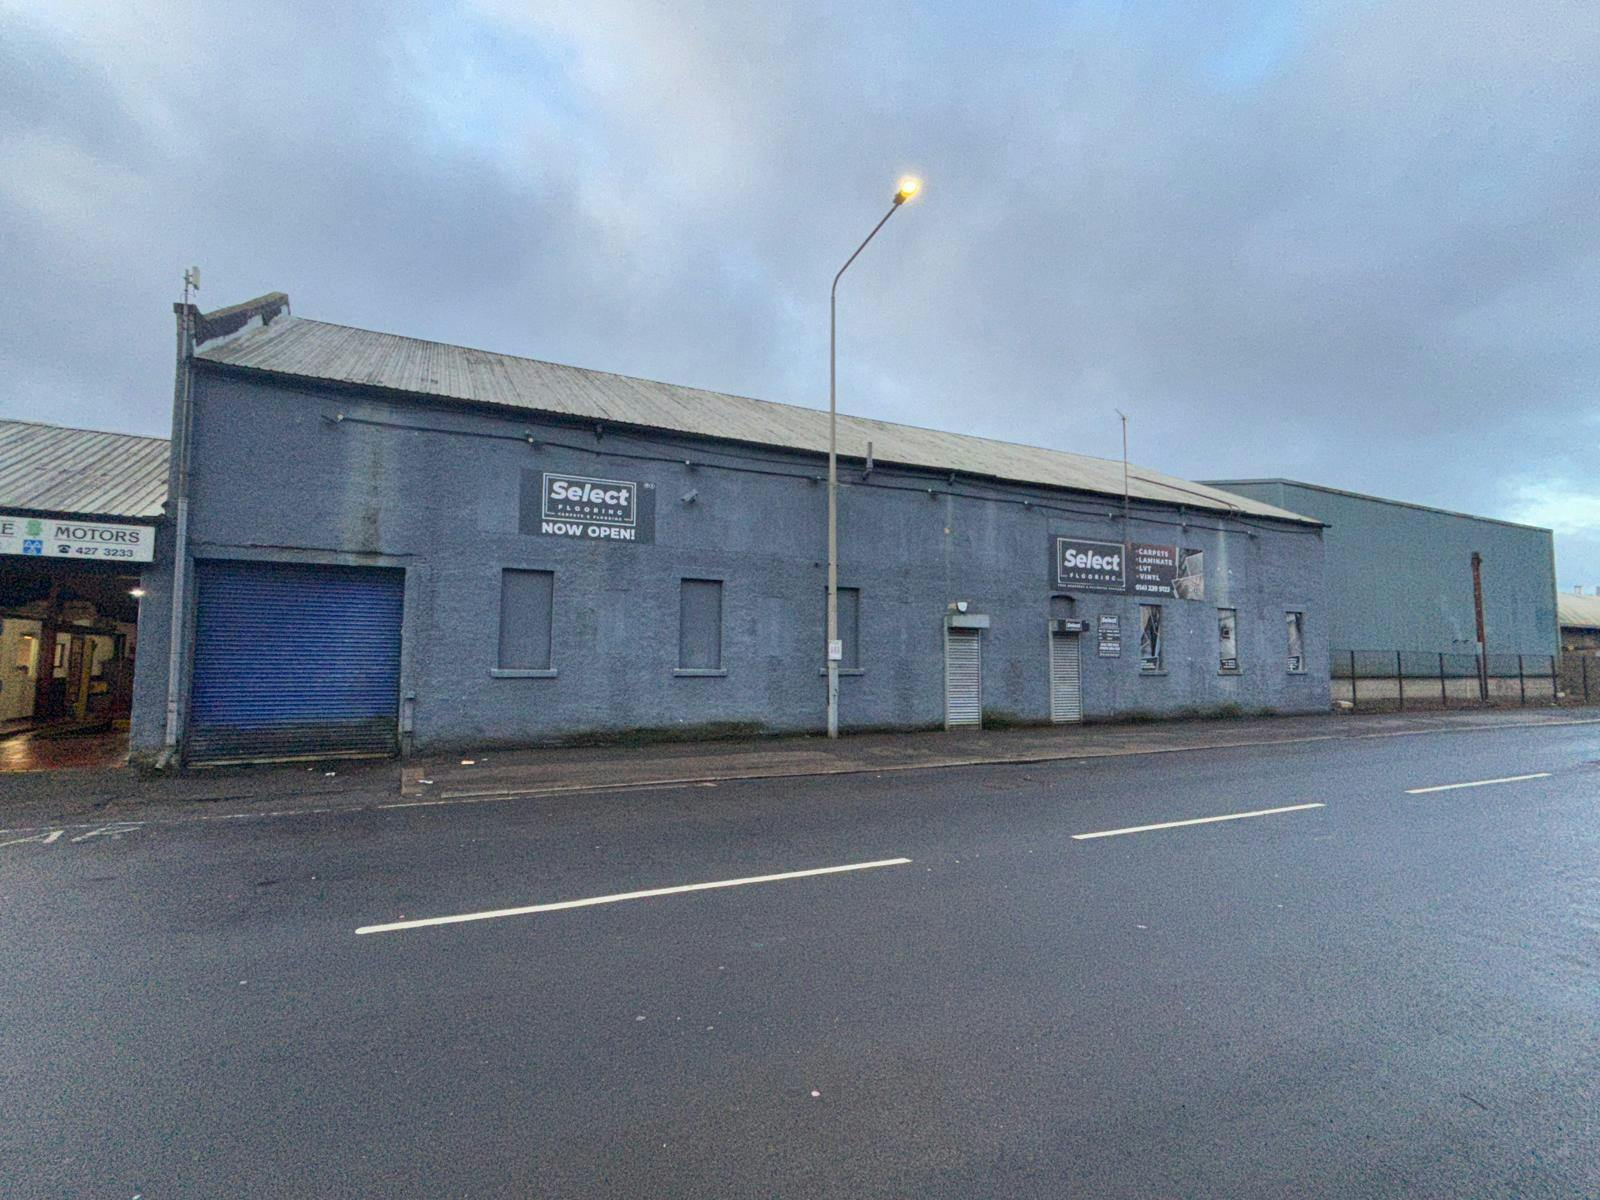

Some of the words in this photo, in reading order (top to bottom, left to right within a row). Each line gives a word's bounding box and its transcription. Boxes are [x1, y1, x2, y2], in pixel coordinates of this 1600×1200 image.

[549, 481, 629, 506] Select
[558, 504, 623, 516] FLOORING
[54, 526, 140, 543] MOTORS
[541, 522, 583, 536] NOW
[588, 525, 635, 540] OPEN!
[75, 546, 98, 555] 427
[103, 547, 134, 558] 3233
[1138, 548, 1169, 558] CARPETS
[1063, 548, 1120, 571] Select
[1138, 556, 1173, 566] LAMINATE
[1138, 564, 1152, 572] LVT
[1069, 572, 1117, 581] FLOORING
[1139, 573, 1161, 581] VINYL
